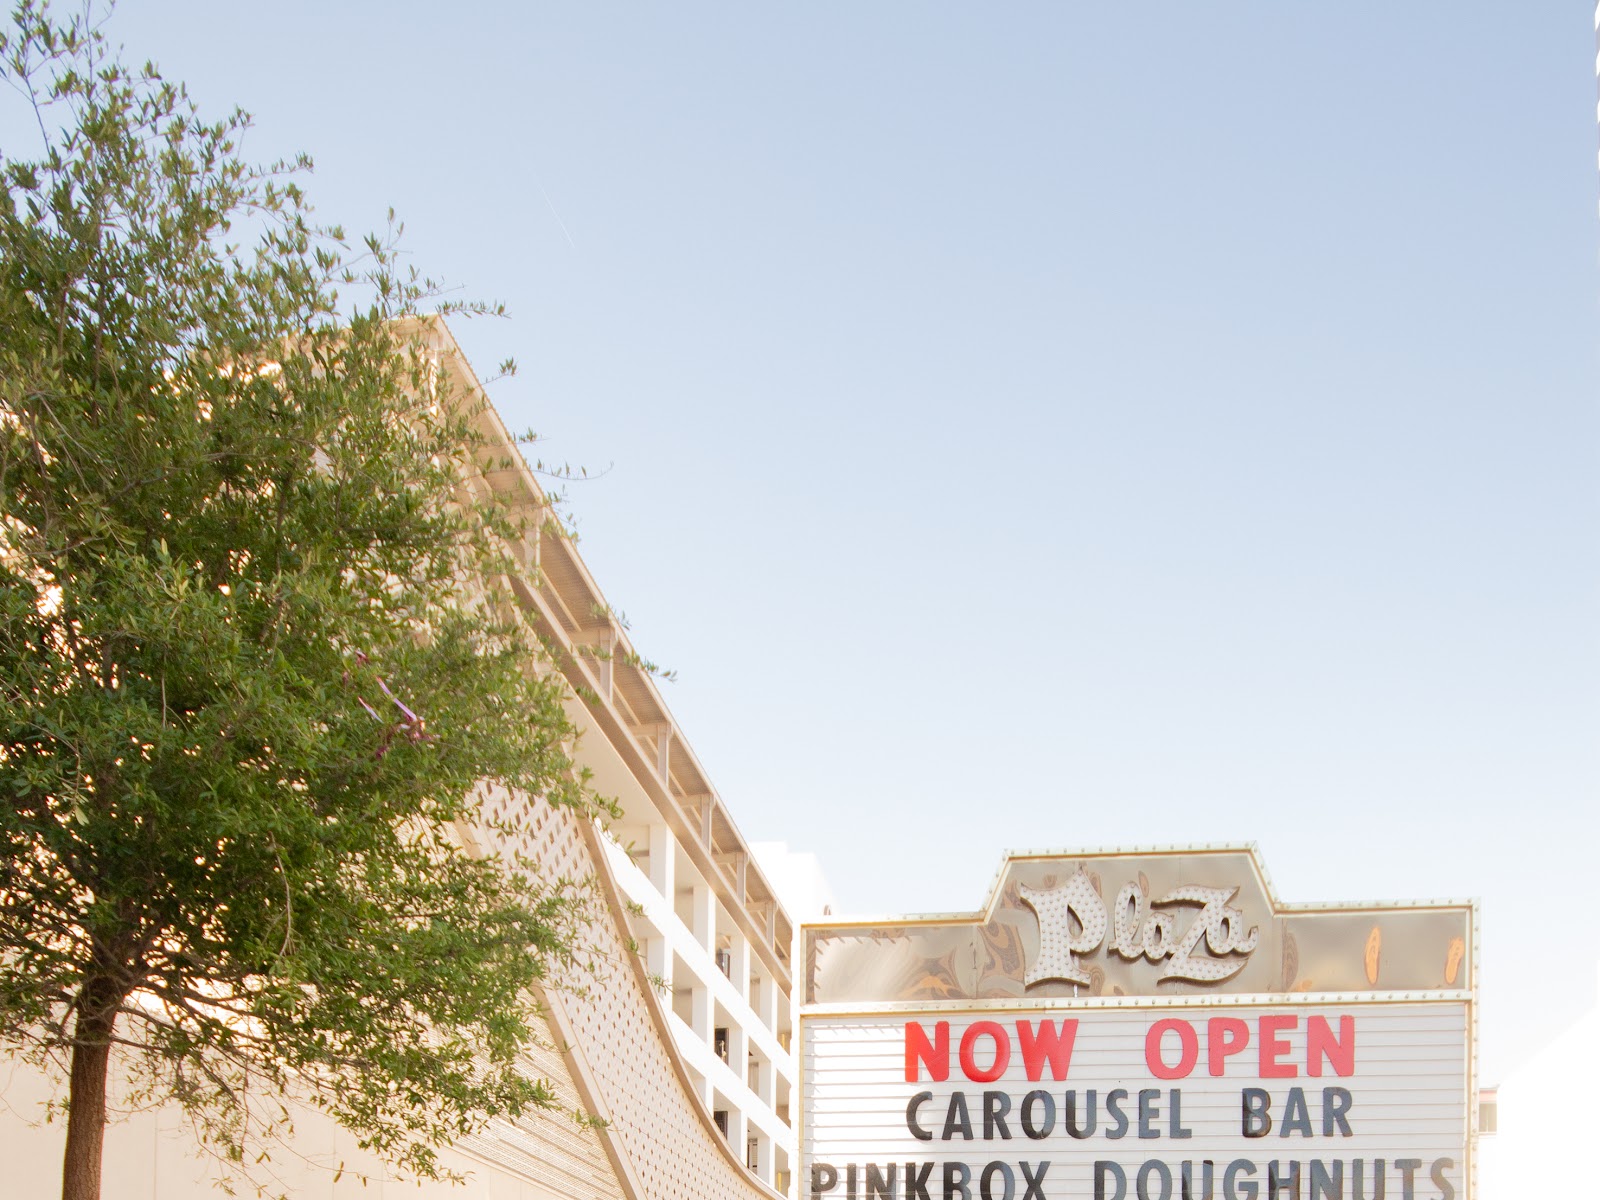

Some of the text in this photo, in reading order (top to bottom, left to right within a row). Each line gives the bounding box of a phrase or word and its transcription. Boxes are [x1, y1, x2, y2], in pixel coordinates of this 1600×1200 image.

[1020, 866, 1259, 991] Plaza
[904, 1015, 1355, 1083] NOW OPEN
[905, 1086, 1354, 1141] CAROUSEL BAR
